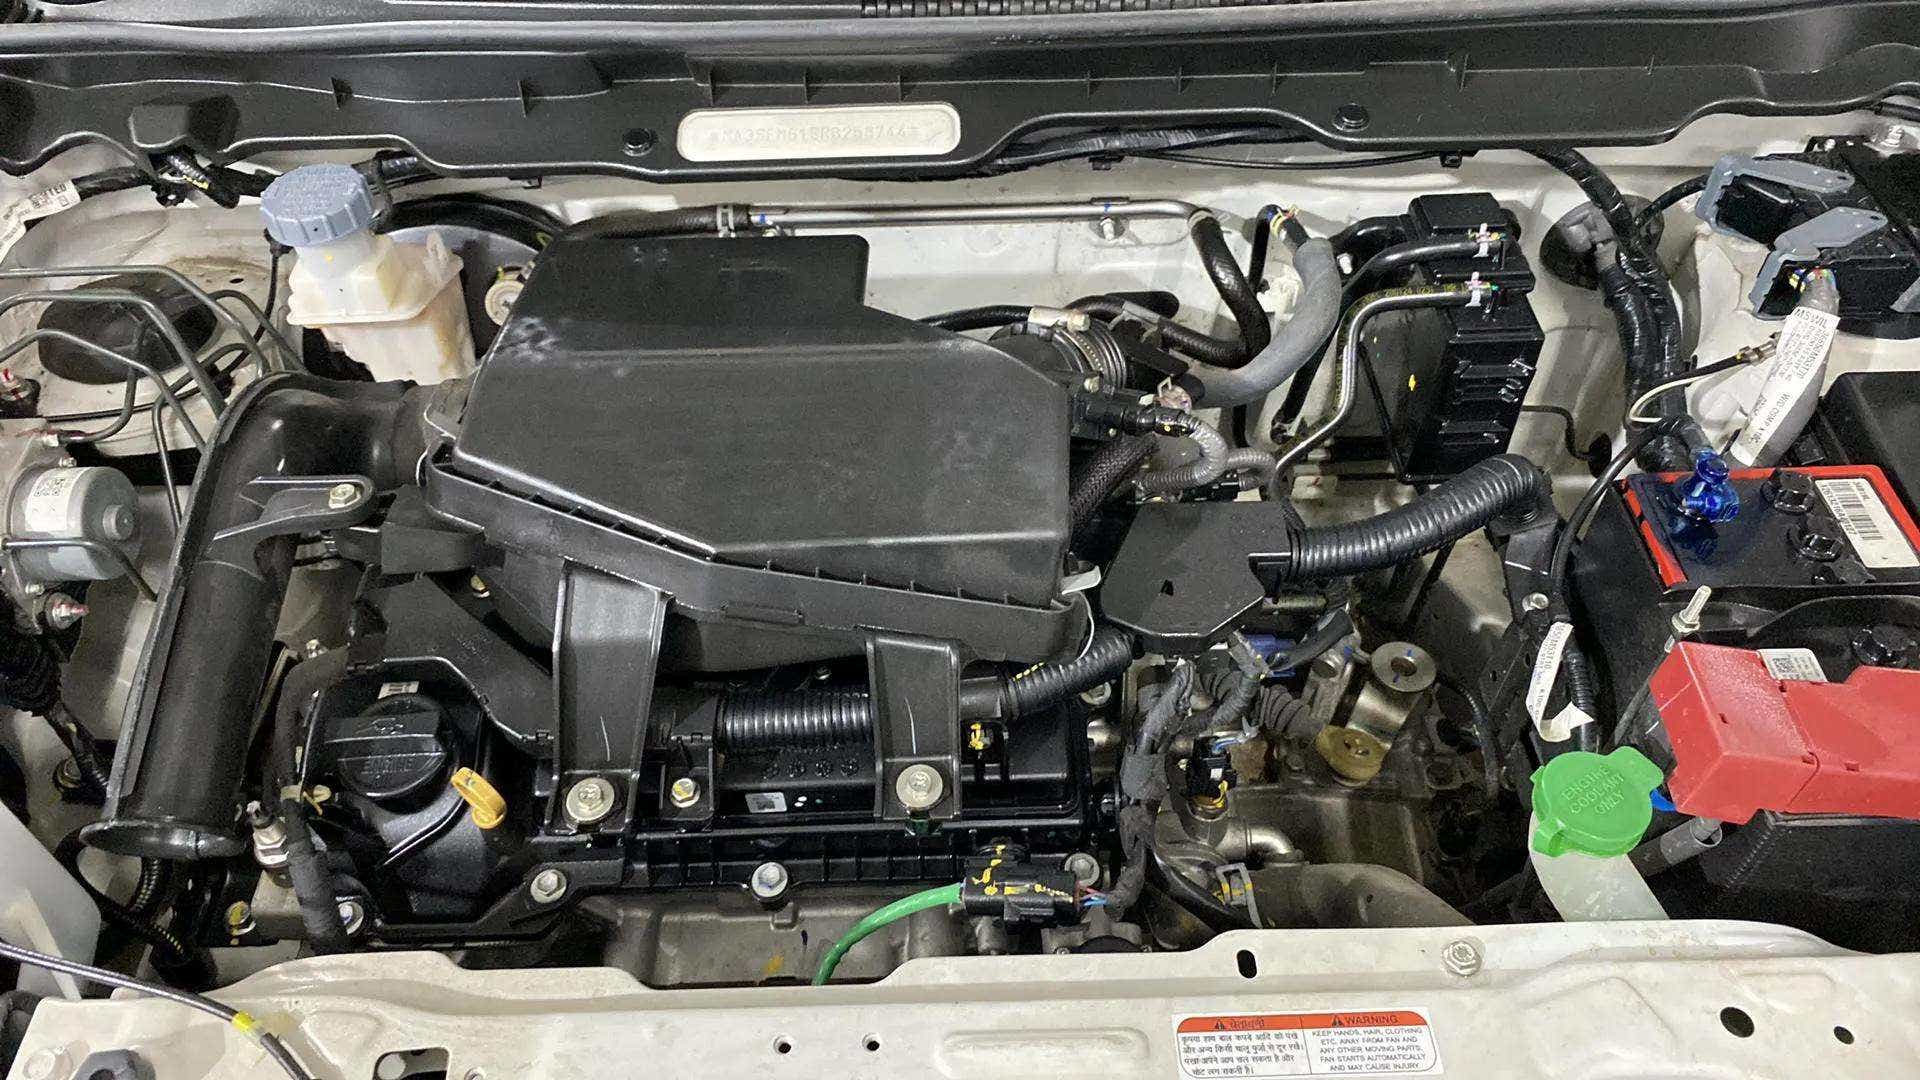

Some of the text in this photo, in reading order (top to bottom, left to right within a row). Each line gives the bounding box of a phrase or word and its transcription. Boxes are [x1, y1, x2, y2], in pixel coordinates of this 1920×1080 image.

[1560, 763, 1611, 801] ENGINE
[1570, 773, 1625, 814] COOLANT
[1593, 790, 1625, 815] ONLY
[1345, 1015, 1399, 1026] WARNING
[1367, 1053, 1426, 1061] AUTOMATICALLY
